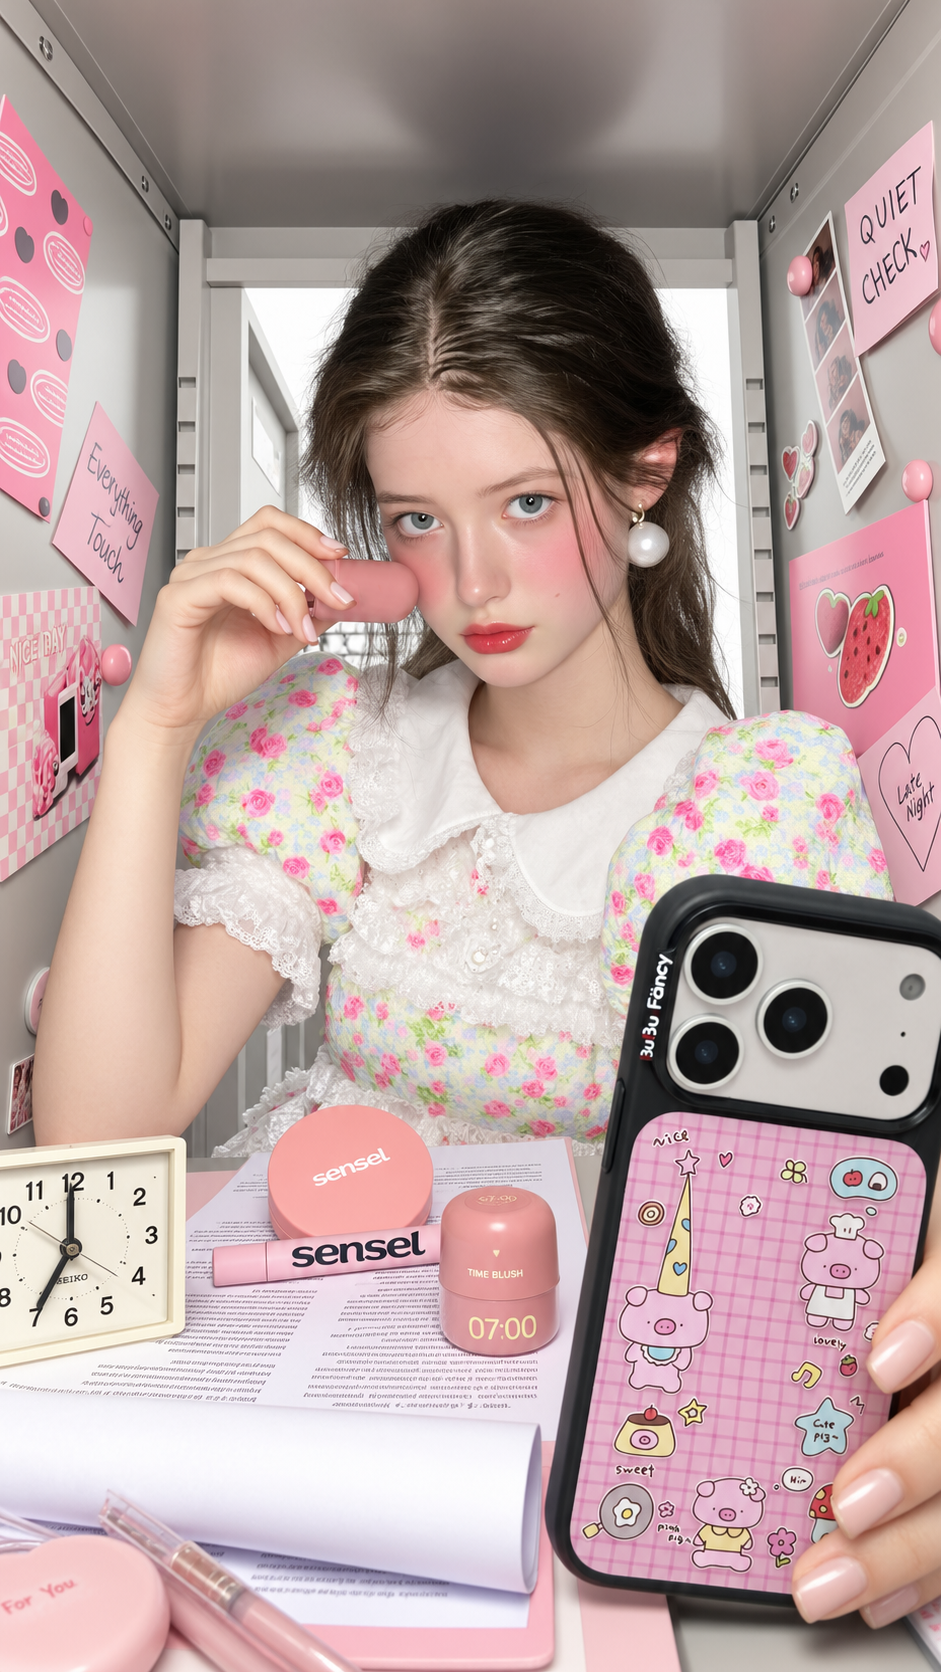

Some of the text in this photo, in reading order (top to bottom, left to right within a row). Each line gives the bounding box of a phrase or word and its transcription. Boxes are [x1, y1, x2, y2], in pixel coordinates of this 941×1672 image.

[860, 166, 921, 244] QUIET
[862, 227, 918, 304] CHECK
[87, 442, 143, 550] Everything
[87, 512, 124, 583] Touch
[9, 634, 40, 676] NICE
[897, 772, 922, 805] Late
[907, 781, 935, 822] Night
[646, 953, 674, 1010] Fäncy
[312, 1147, 391, 1186] sensel
[25, 1180, 43, 1201] 11
[62, 1172, 85, 1193] 12
[107, 1171, 114, 1190] 1
[133, 1187, 147, 1207] 2
[145, 1225, 159, 1244] 3
[292, 1230, 426, 1268] sensel
[56, 1273, 89, 1285] SEIKO
[131, 1266, 146, 1286] 4
[467, 1268, 523, 1279] TIME BLUSH
[100, 1295, 114, 1316] 5
[29, 1307, 43, 1327] 7
[64, 1307, 79, 1327] 6
[469, 1315, 537, 1341] 07:00
[813, 1336, 847, 1352] lovely
[615, 1464, 655, 1478] sweet
[1, 1579, 77, 1615] For You
